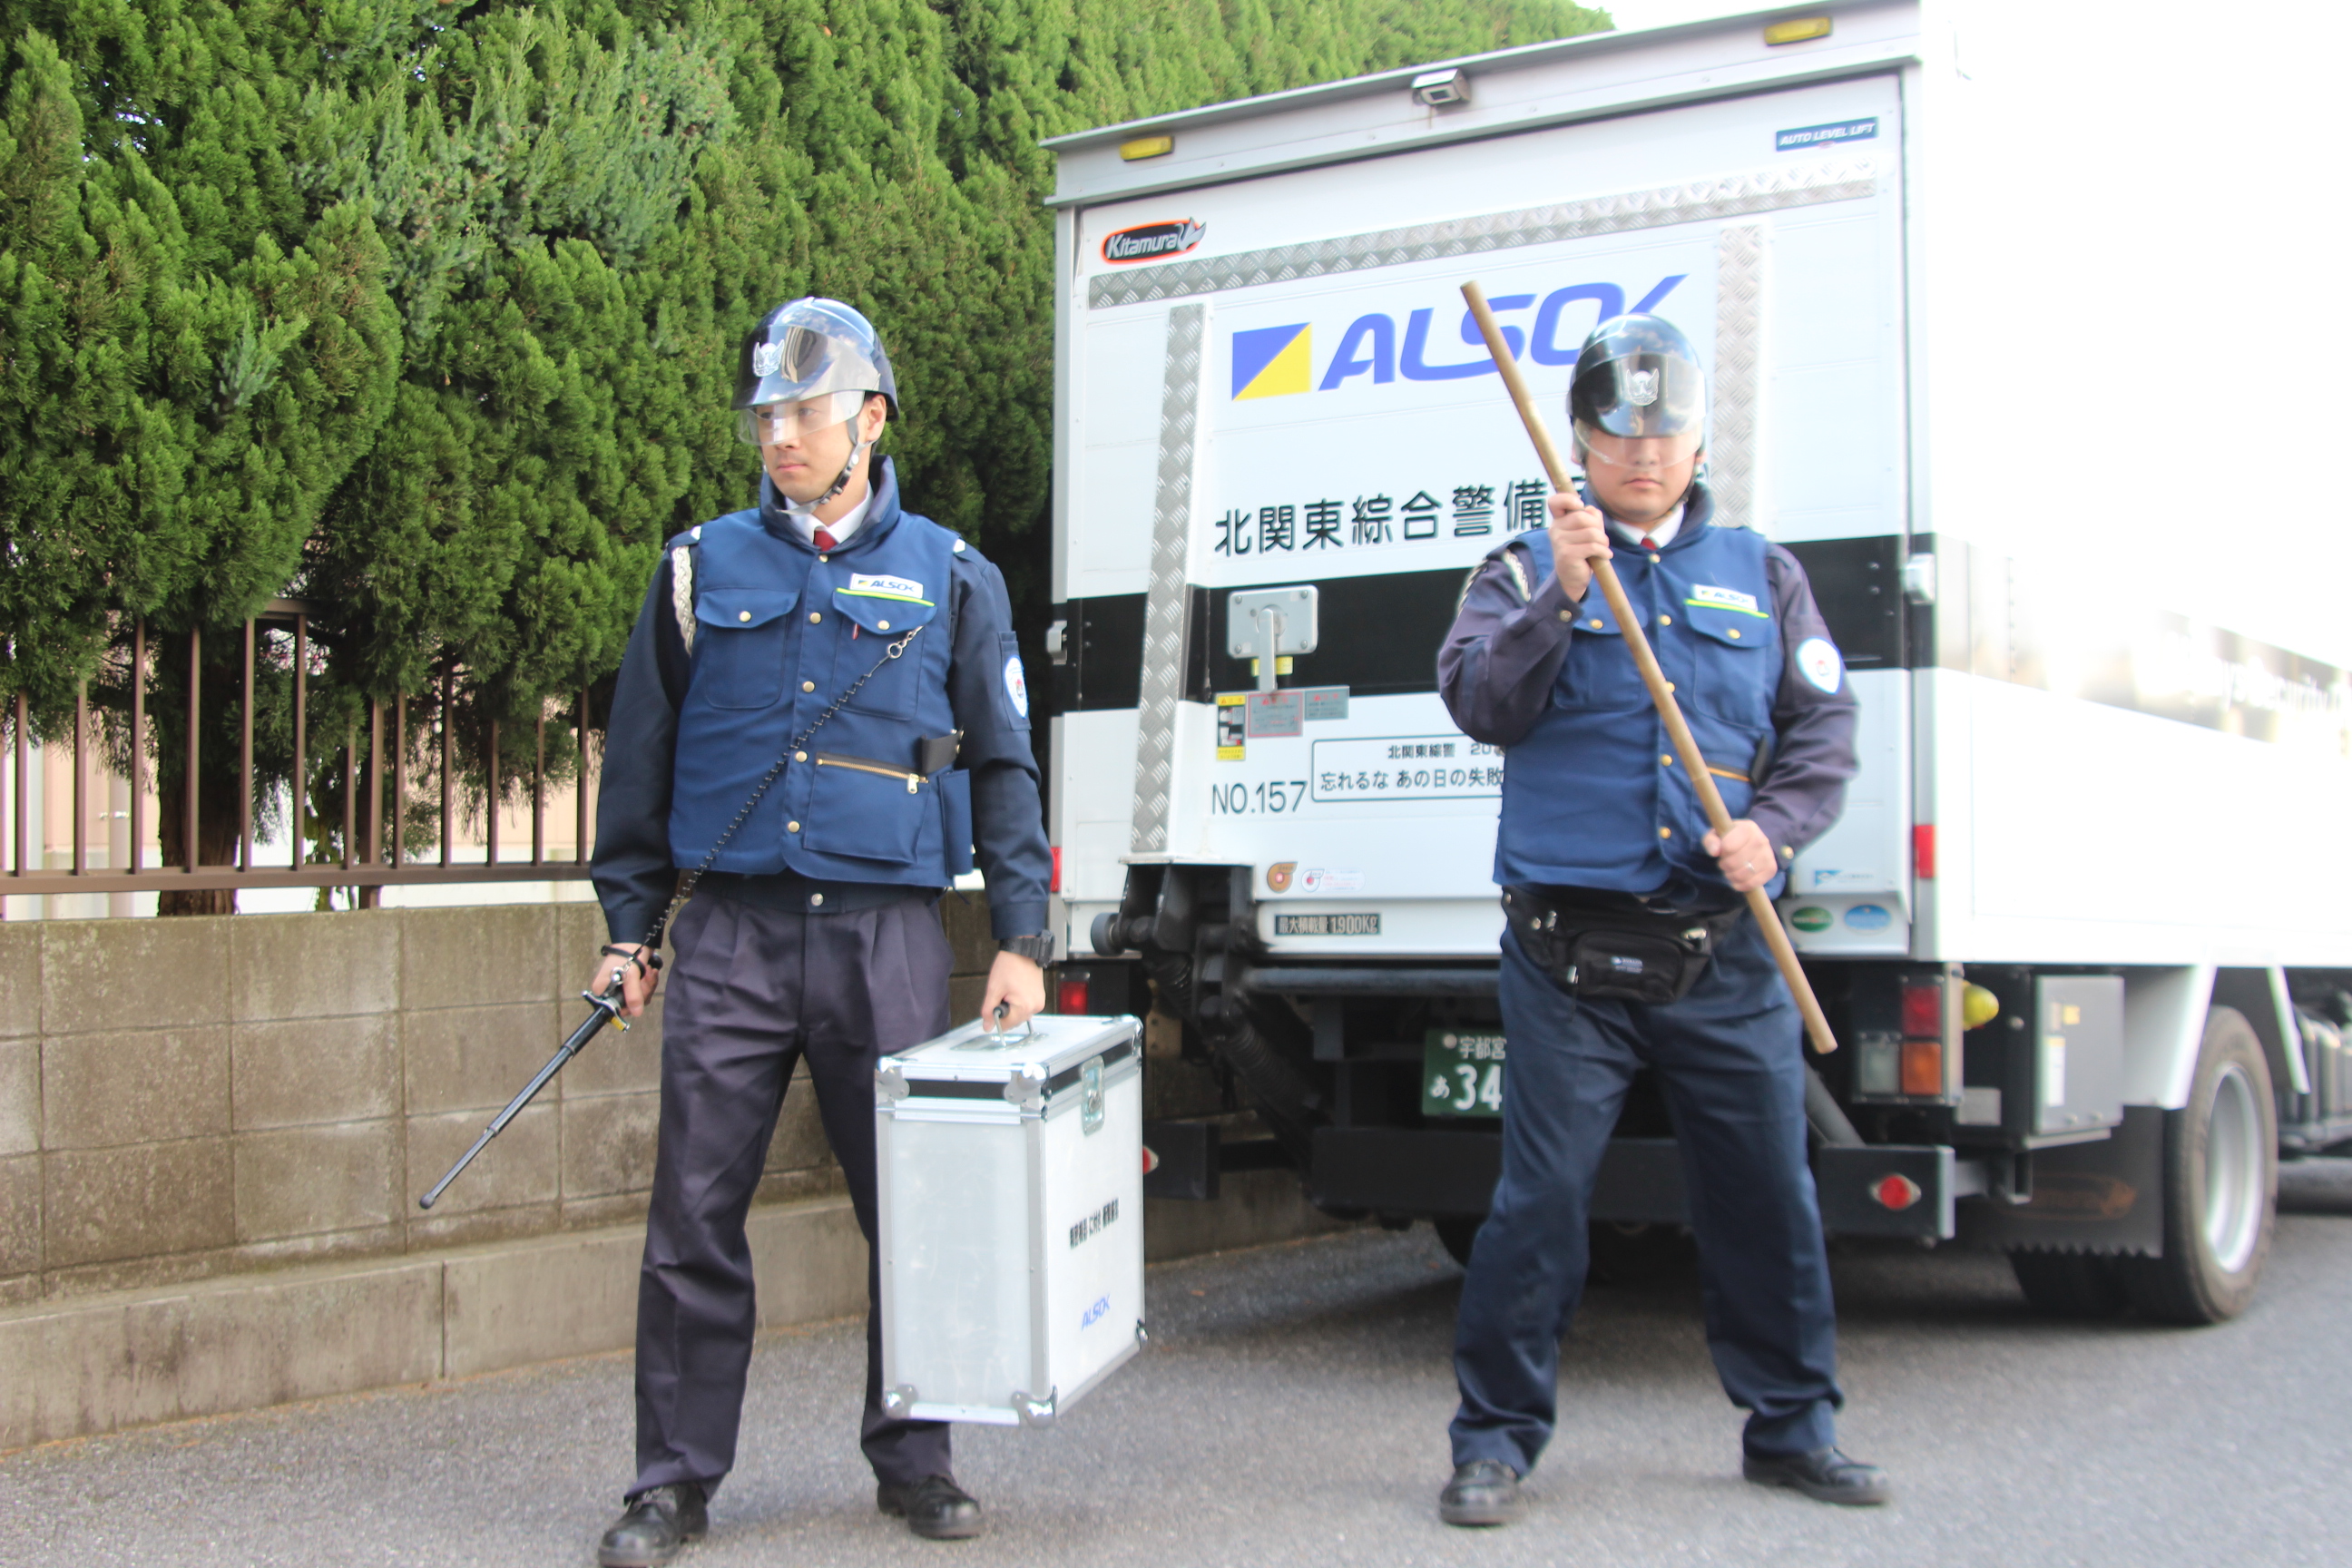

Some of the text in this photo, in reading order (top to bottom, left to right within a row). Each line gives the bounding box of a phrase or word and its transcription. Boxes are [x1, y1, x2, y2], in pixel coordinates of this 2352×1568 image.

[1779, 122, 1877, 146] AUTO LEVEL LIFT
[1106, 232, 1179, 260] Kitamura
[1214, 475, 1586, 558] 北関東綜合警備
[870, 579, 916, 593] ALSOK
[1320, 767, 1504, 792] 忘れるな あの日の失敗
[1211, 780, 1308, 816] NO.157
[1459, 1035, 1507, 1060] 宇都宮
[1428, 1074, 1451, 1099] あ
[1080, 1292, 1111, 1332] ALSOK
